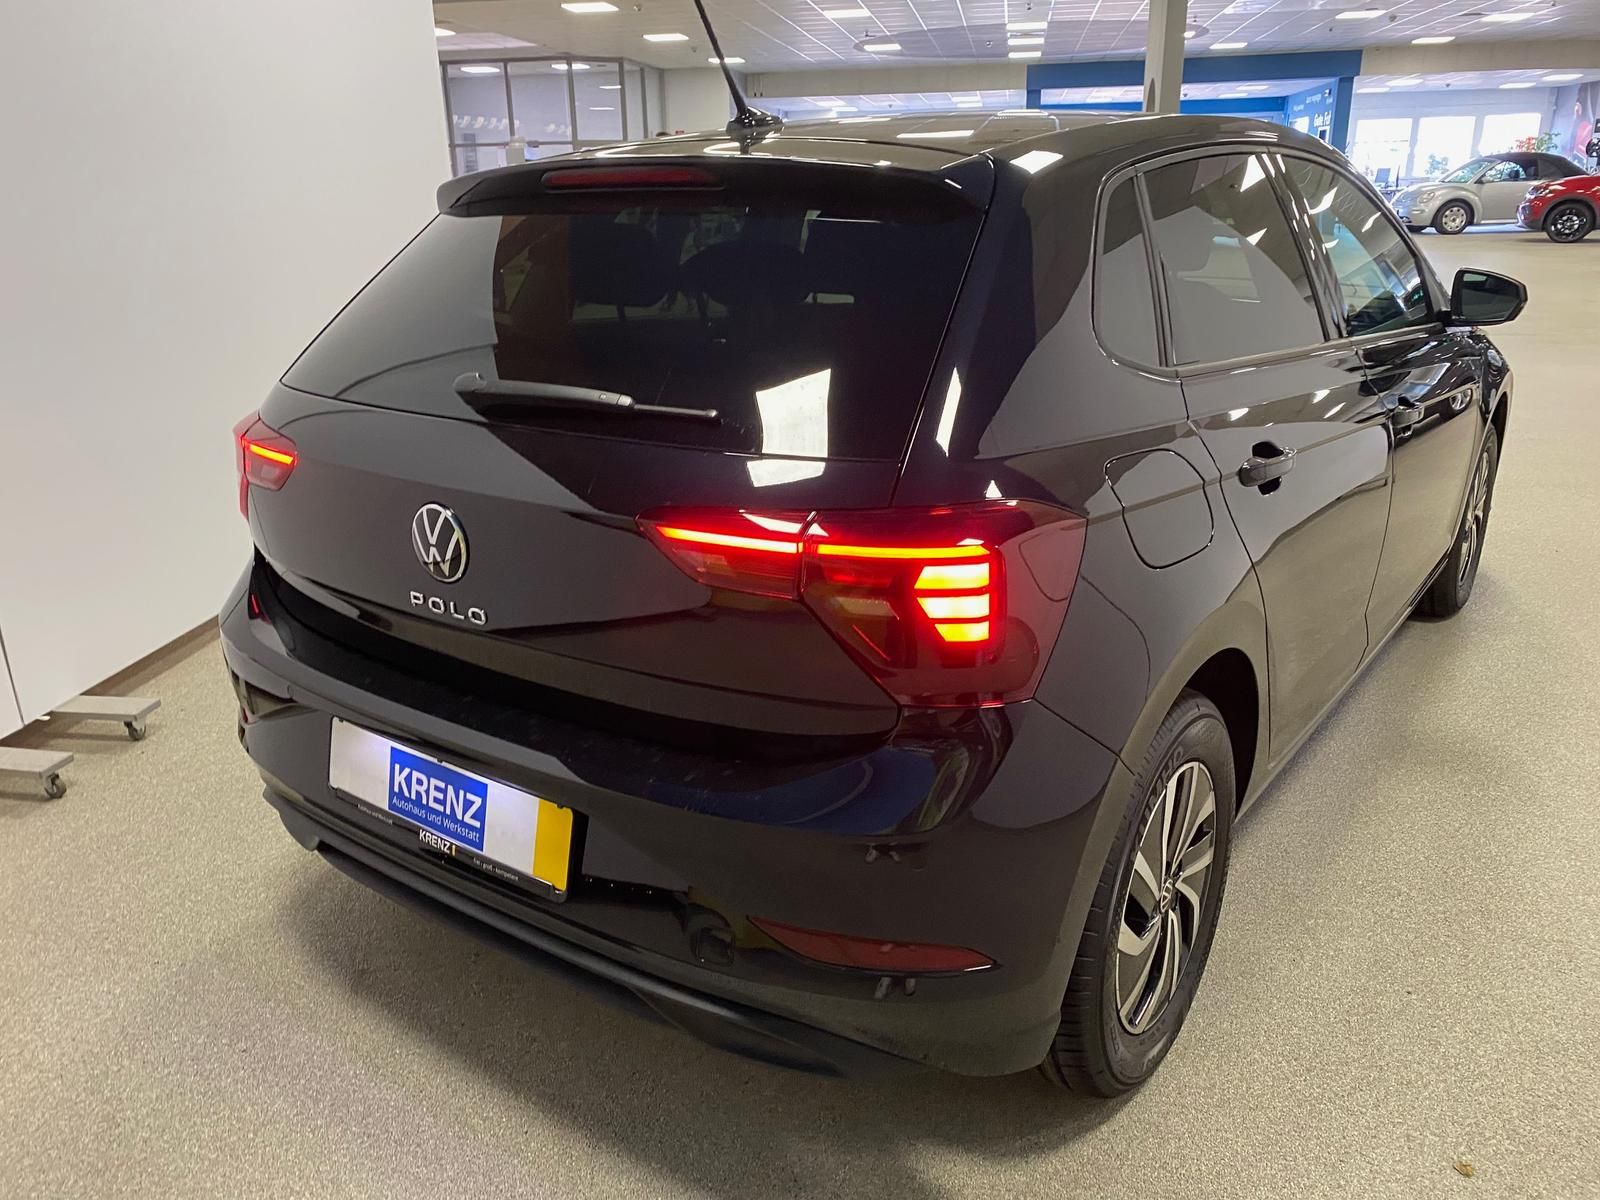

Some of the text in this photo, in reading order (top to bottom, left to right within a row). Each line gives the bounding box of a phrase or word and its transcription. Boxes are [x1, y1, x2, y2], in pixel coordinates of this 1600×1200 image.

[409, 591, 488, 626] POLO
[393, 763, 482, 828] KRENZ
[392, 796, 426, 818] Autohaus
[427, 813, 442, 825] und
[443, 817, 480, 843] Werkstatt
[419, 829, 450, 854] KRENZ
